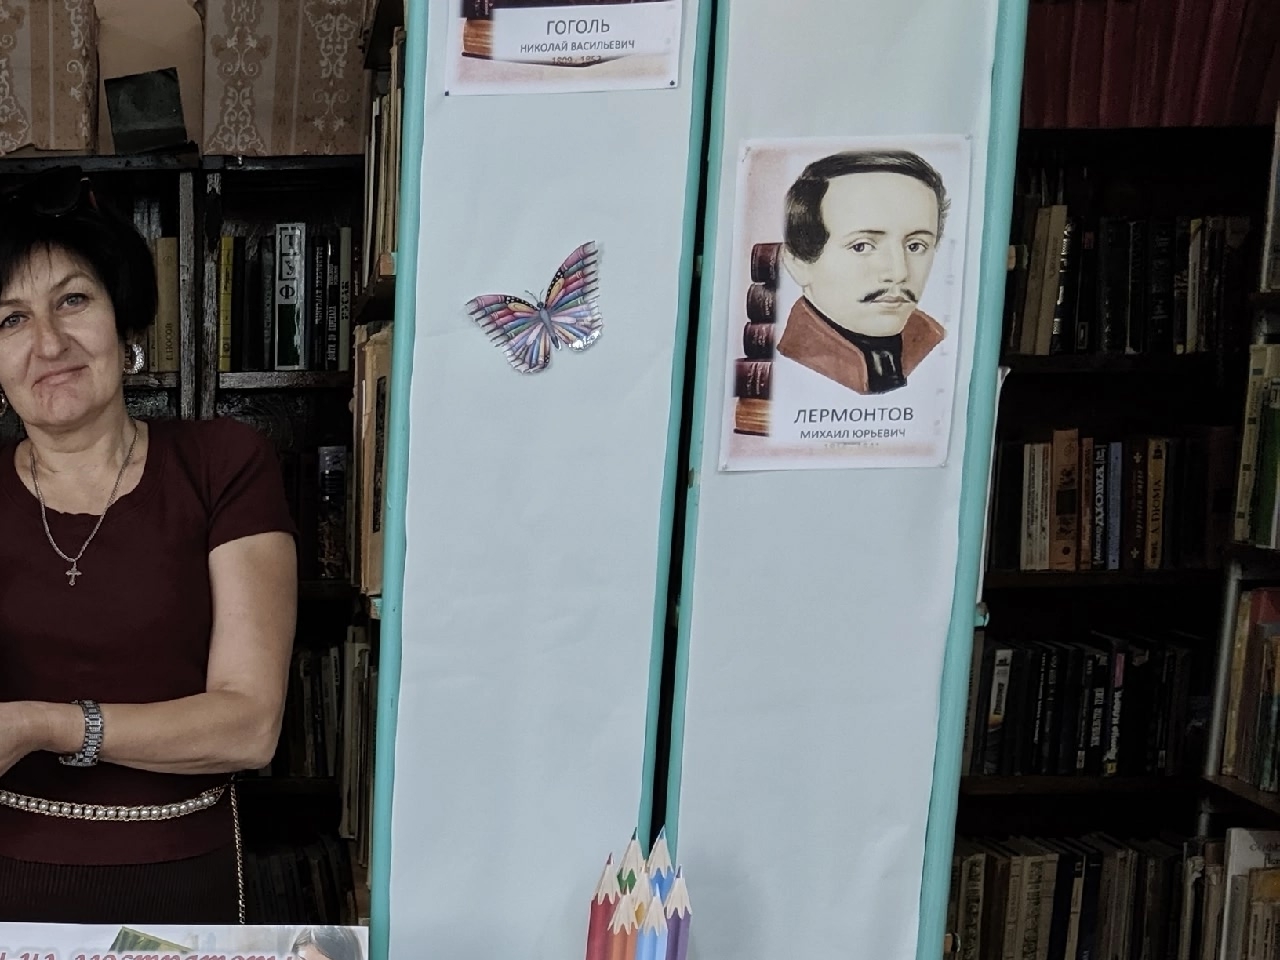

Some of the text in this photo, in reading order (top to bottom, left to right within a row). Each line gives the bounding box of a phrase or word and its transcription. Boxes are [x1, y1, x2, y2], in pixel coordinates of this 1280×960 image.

[546, 19, 610, 35] ГОГОЛЬ
[520, 39, 635, 53] НИКОЛАЙ ВАСИЛЬЕВИЧ
[793, 407, 914, 424] ЛЕРМОНТОВ
[800, 428, 906, 439] МИХАИЛ ЮРЬЕВИЧ
